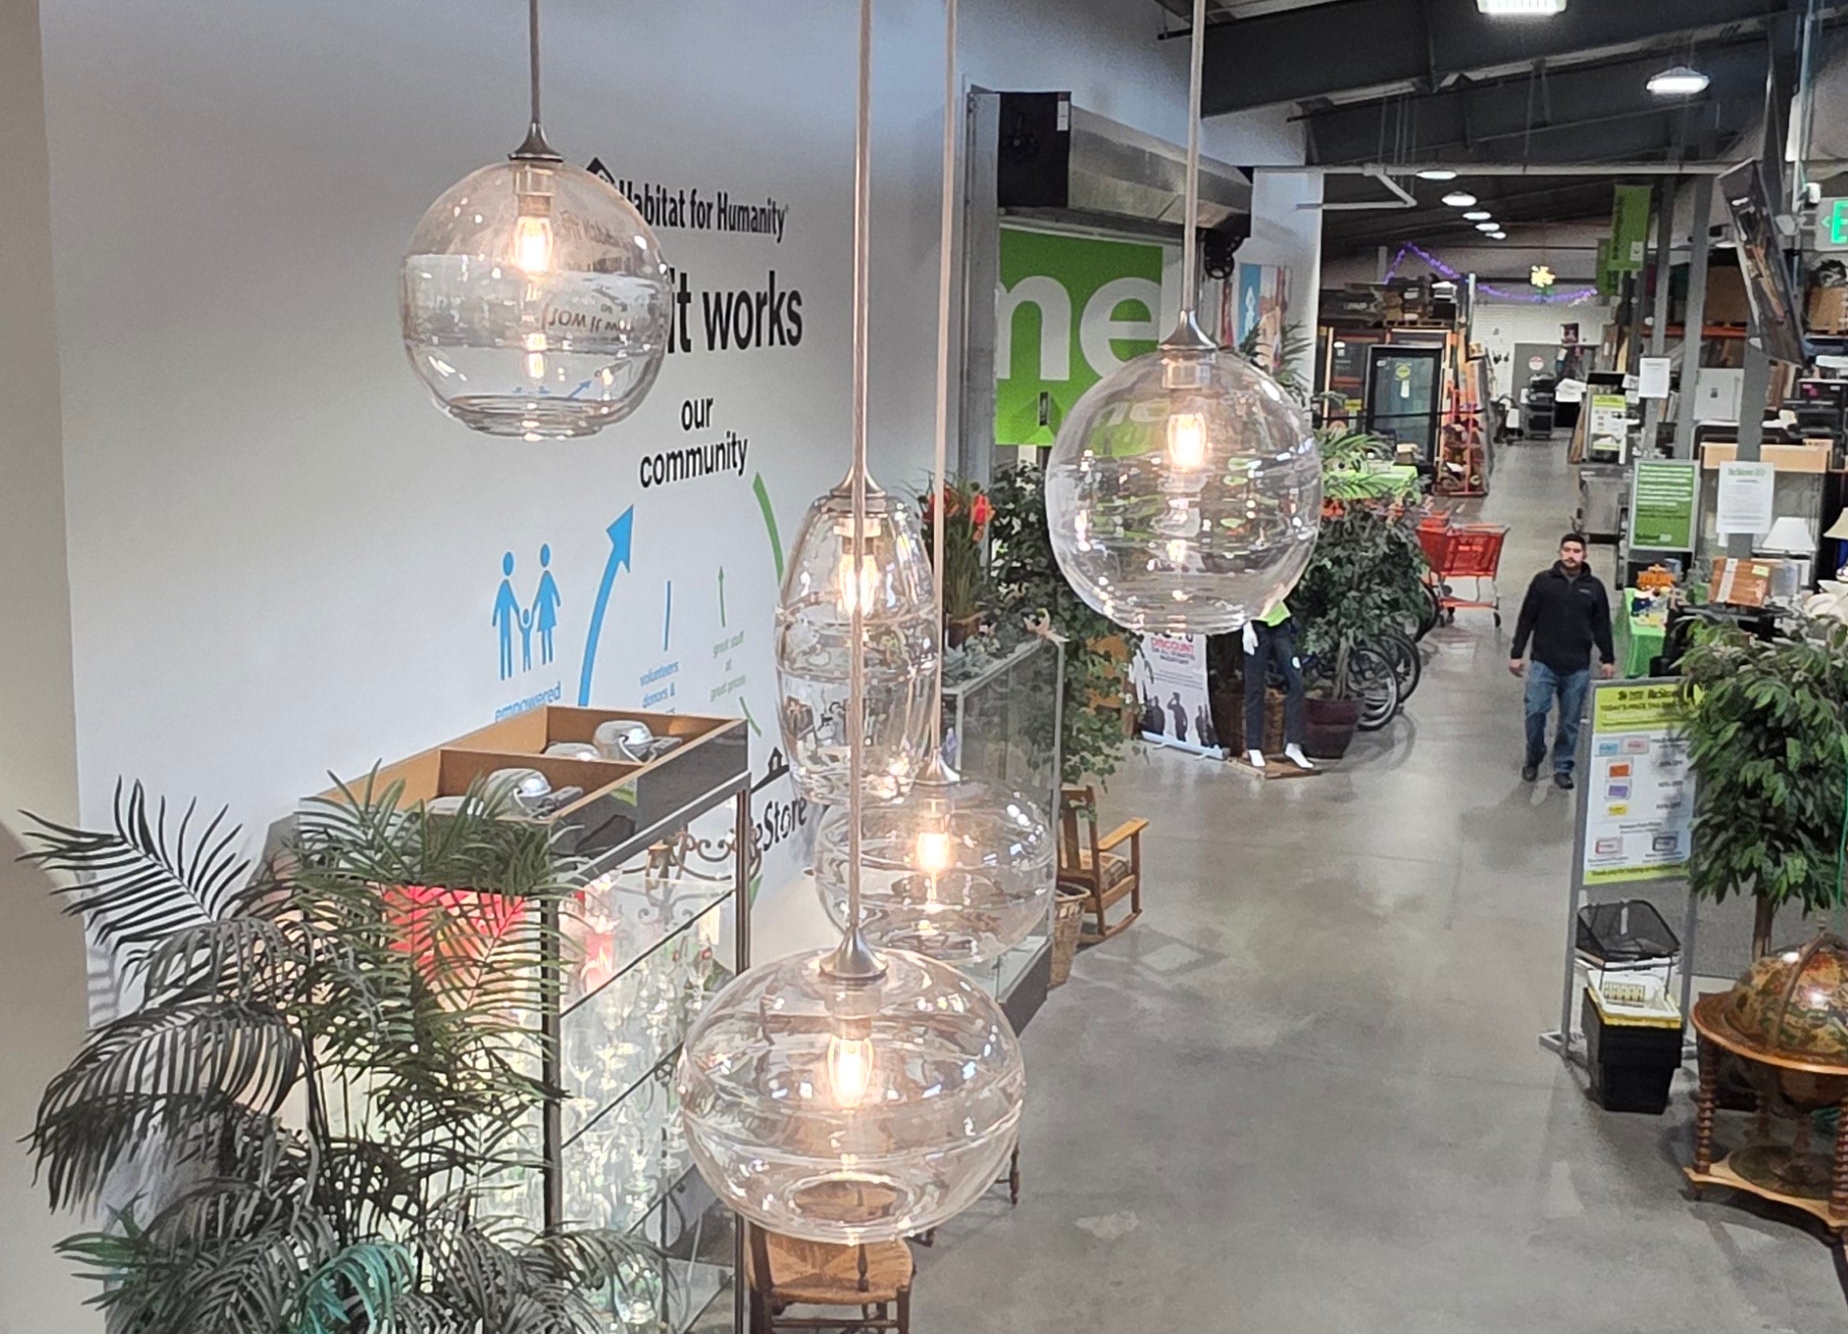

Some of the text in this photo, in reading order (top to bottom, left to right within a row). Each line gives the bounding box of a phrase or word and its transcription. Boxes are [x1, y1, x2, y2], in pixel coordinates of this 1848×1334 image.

[690, 188, 713, 230] for
[717, 191, 786, 244] Humanity
[702, 270, 803, 350] works
[681, 397, 713, 431] our
[640, 430, 748, 488] community
[639, 661, 679, 687] volunteers
[495, 680, 561, 723] empowered
[642, 688, 668, 709] donors
